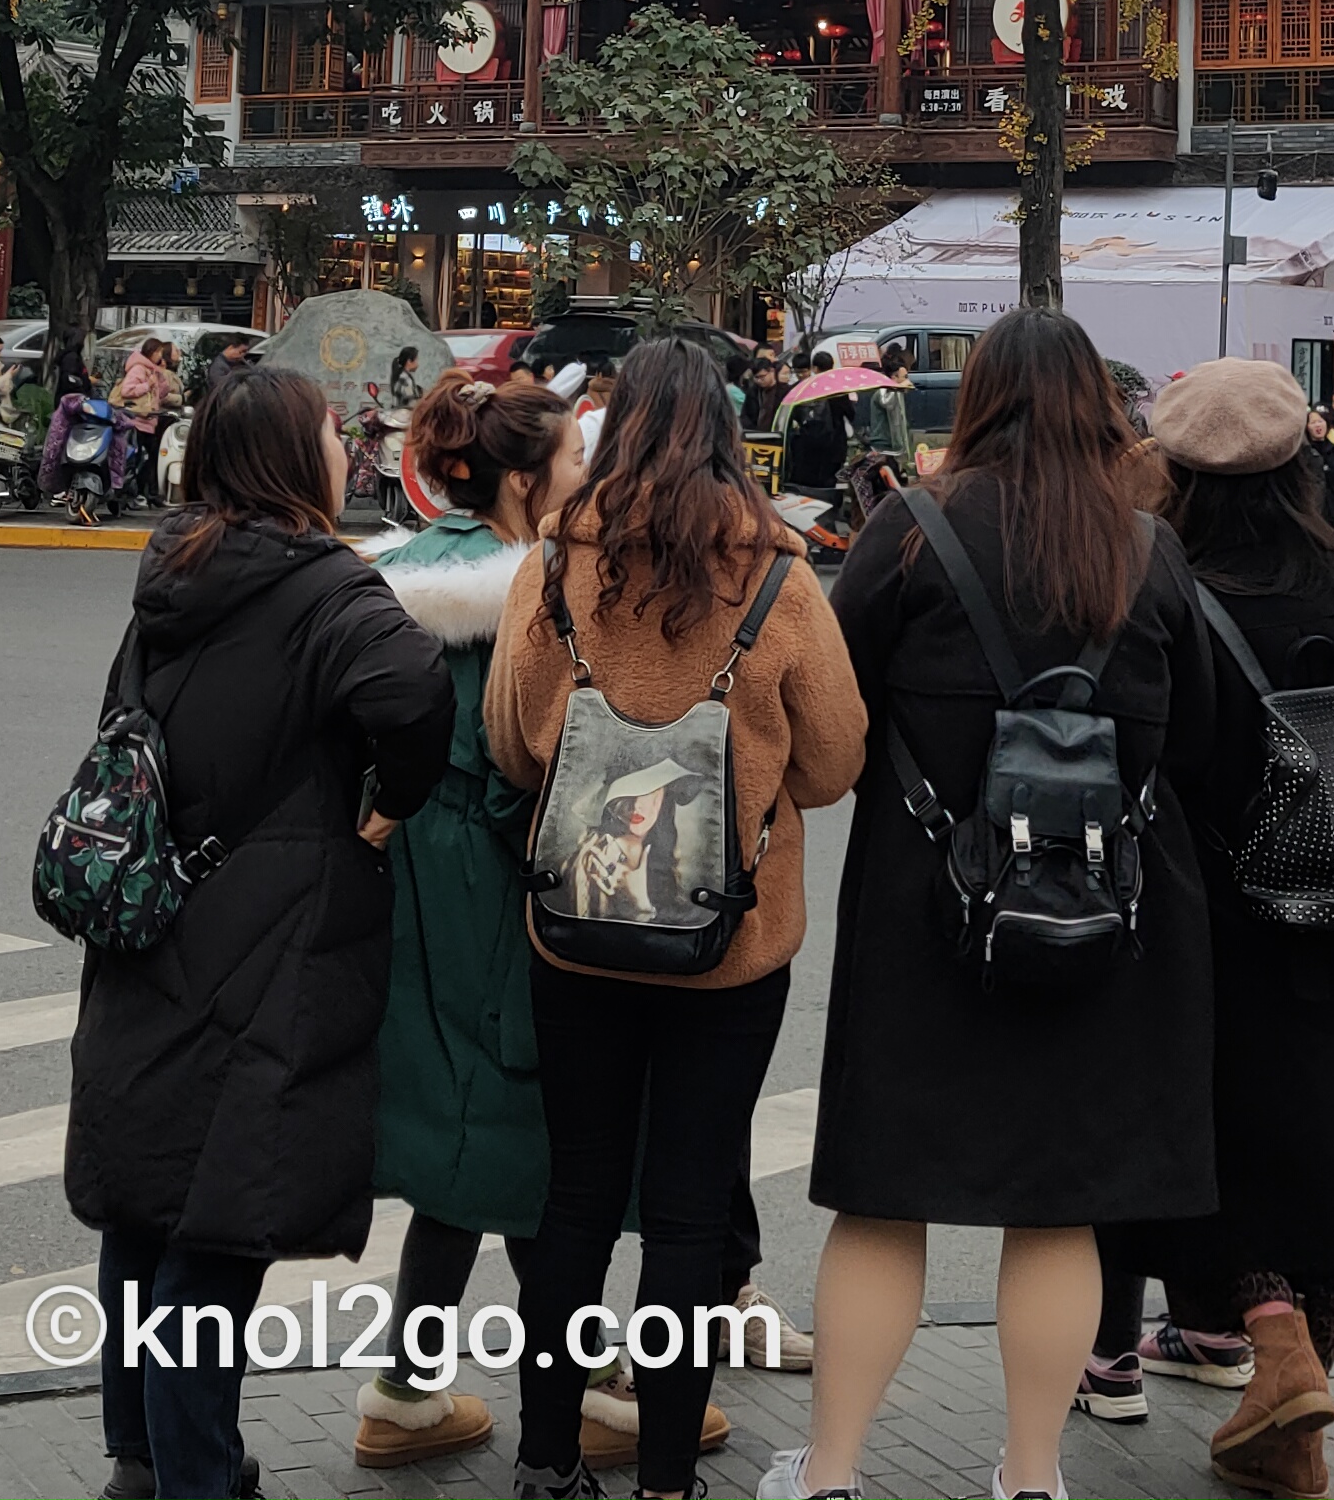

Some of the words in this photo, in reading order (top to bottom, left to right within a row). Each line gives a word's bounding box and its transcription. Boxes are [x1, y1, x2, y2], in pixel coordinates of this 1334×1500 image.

[984, 84, 1128, 111] 看戏
[381, 101, 495, 125] 吃火锅
